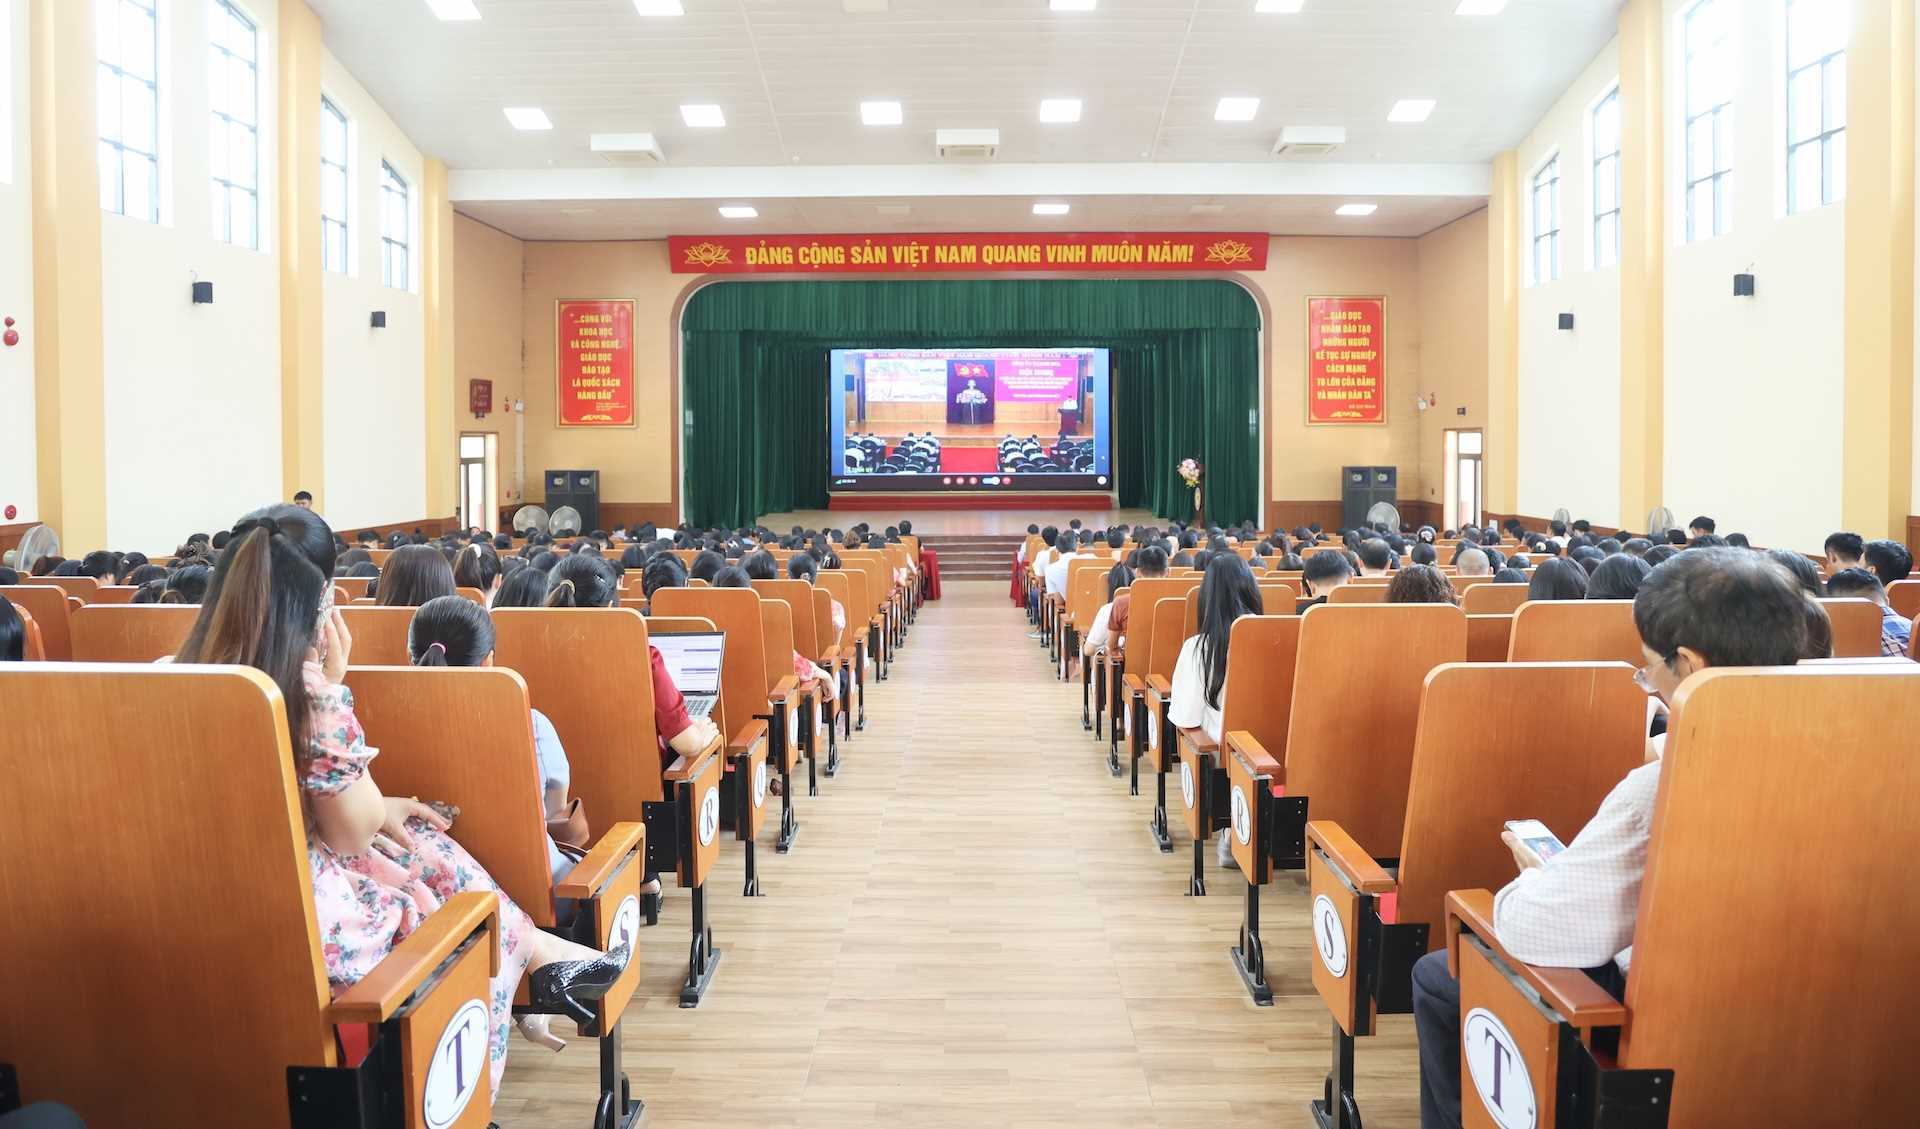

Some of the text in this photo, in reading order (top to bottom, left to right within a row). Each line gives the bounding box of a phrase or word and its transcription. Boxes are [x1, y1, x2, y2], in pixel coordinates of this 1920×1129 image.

[745, 239, 1194, 268] ĐẢNG CỘNG SẢN VIỆT NAM QUANG VINH MUÔN NĂM!
[705, 798, 714, 835] R
[1324, 910, 1335, 960] S
[446, 1018, 471, 1101] T
[1484, 1026, 1512, 1113] T
